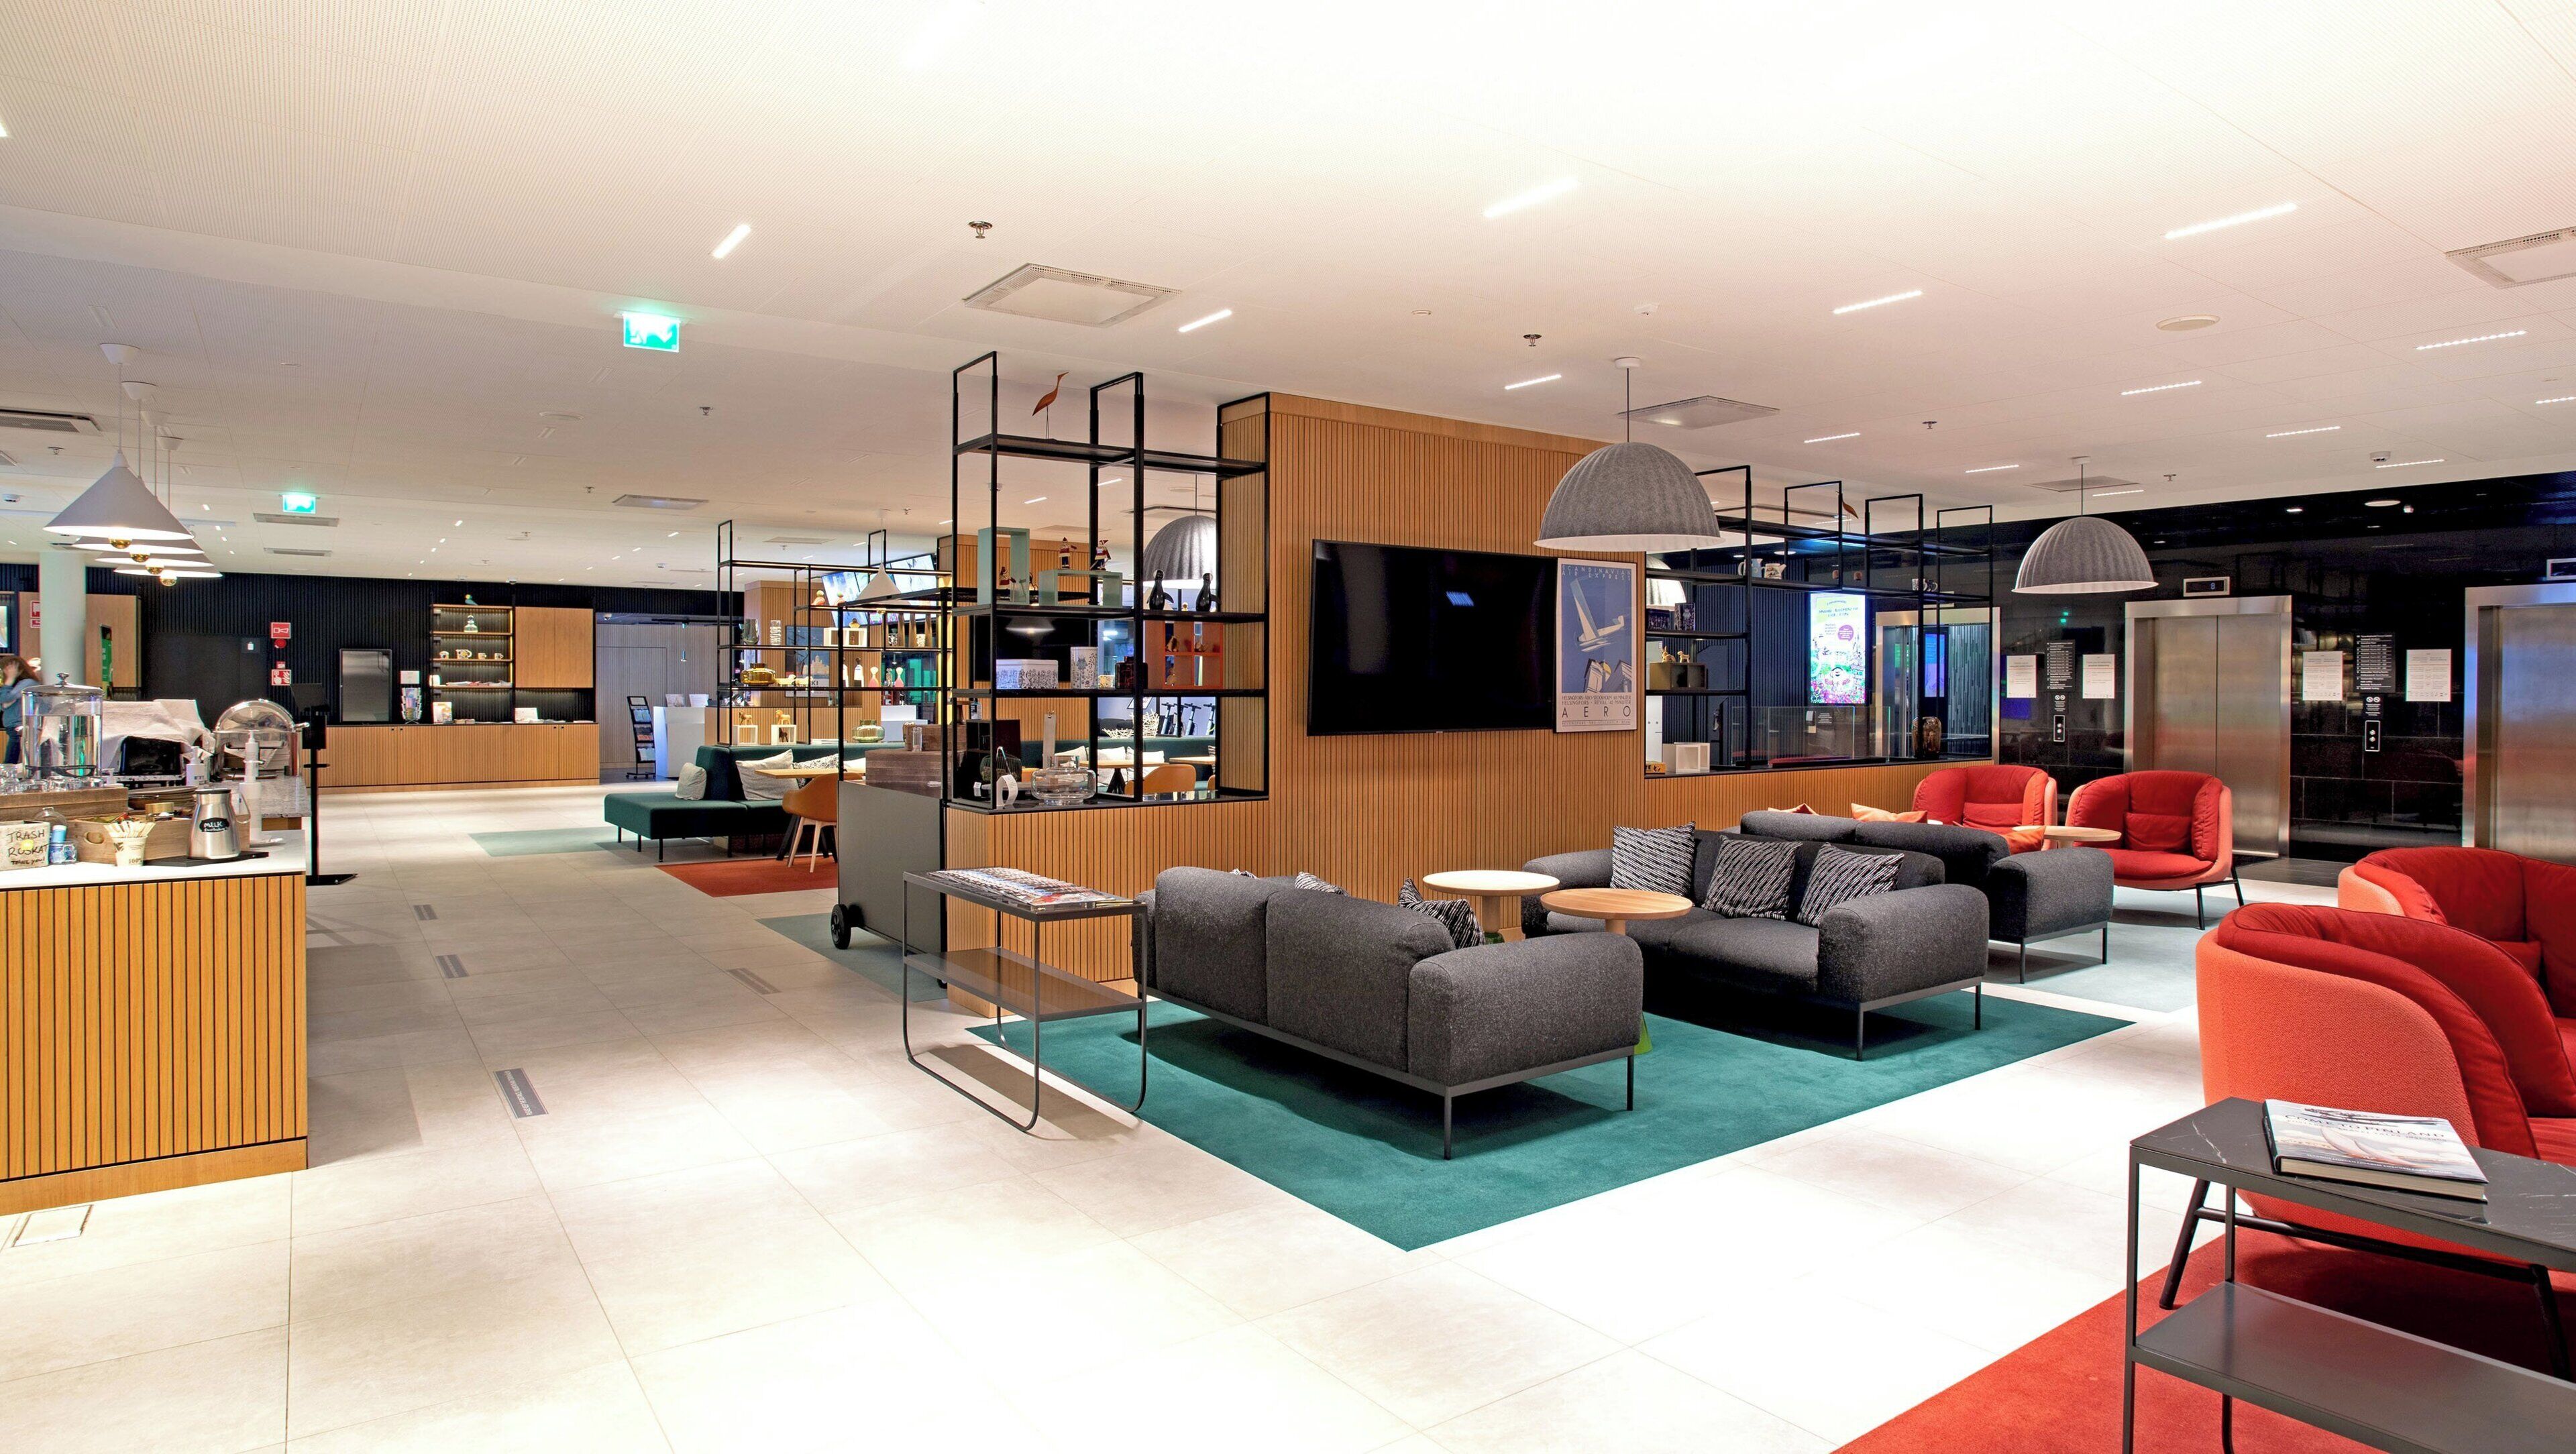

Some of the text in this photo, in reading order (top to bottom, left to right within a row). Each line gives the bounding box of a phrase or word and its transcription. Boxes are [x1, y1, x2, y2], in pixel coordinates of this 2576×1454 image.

[1562, 565, 1631, 575] SCANDINAVIAN
[1587, 573, 1631, 581] EXPRESS
[1562, 706, 1631, 718] AERO
[6, 829, 45, 843] TRASH
[2285, 1115, 2334, 1126] COME
[2365, 1125, 2445, 1137] FINLAND
